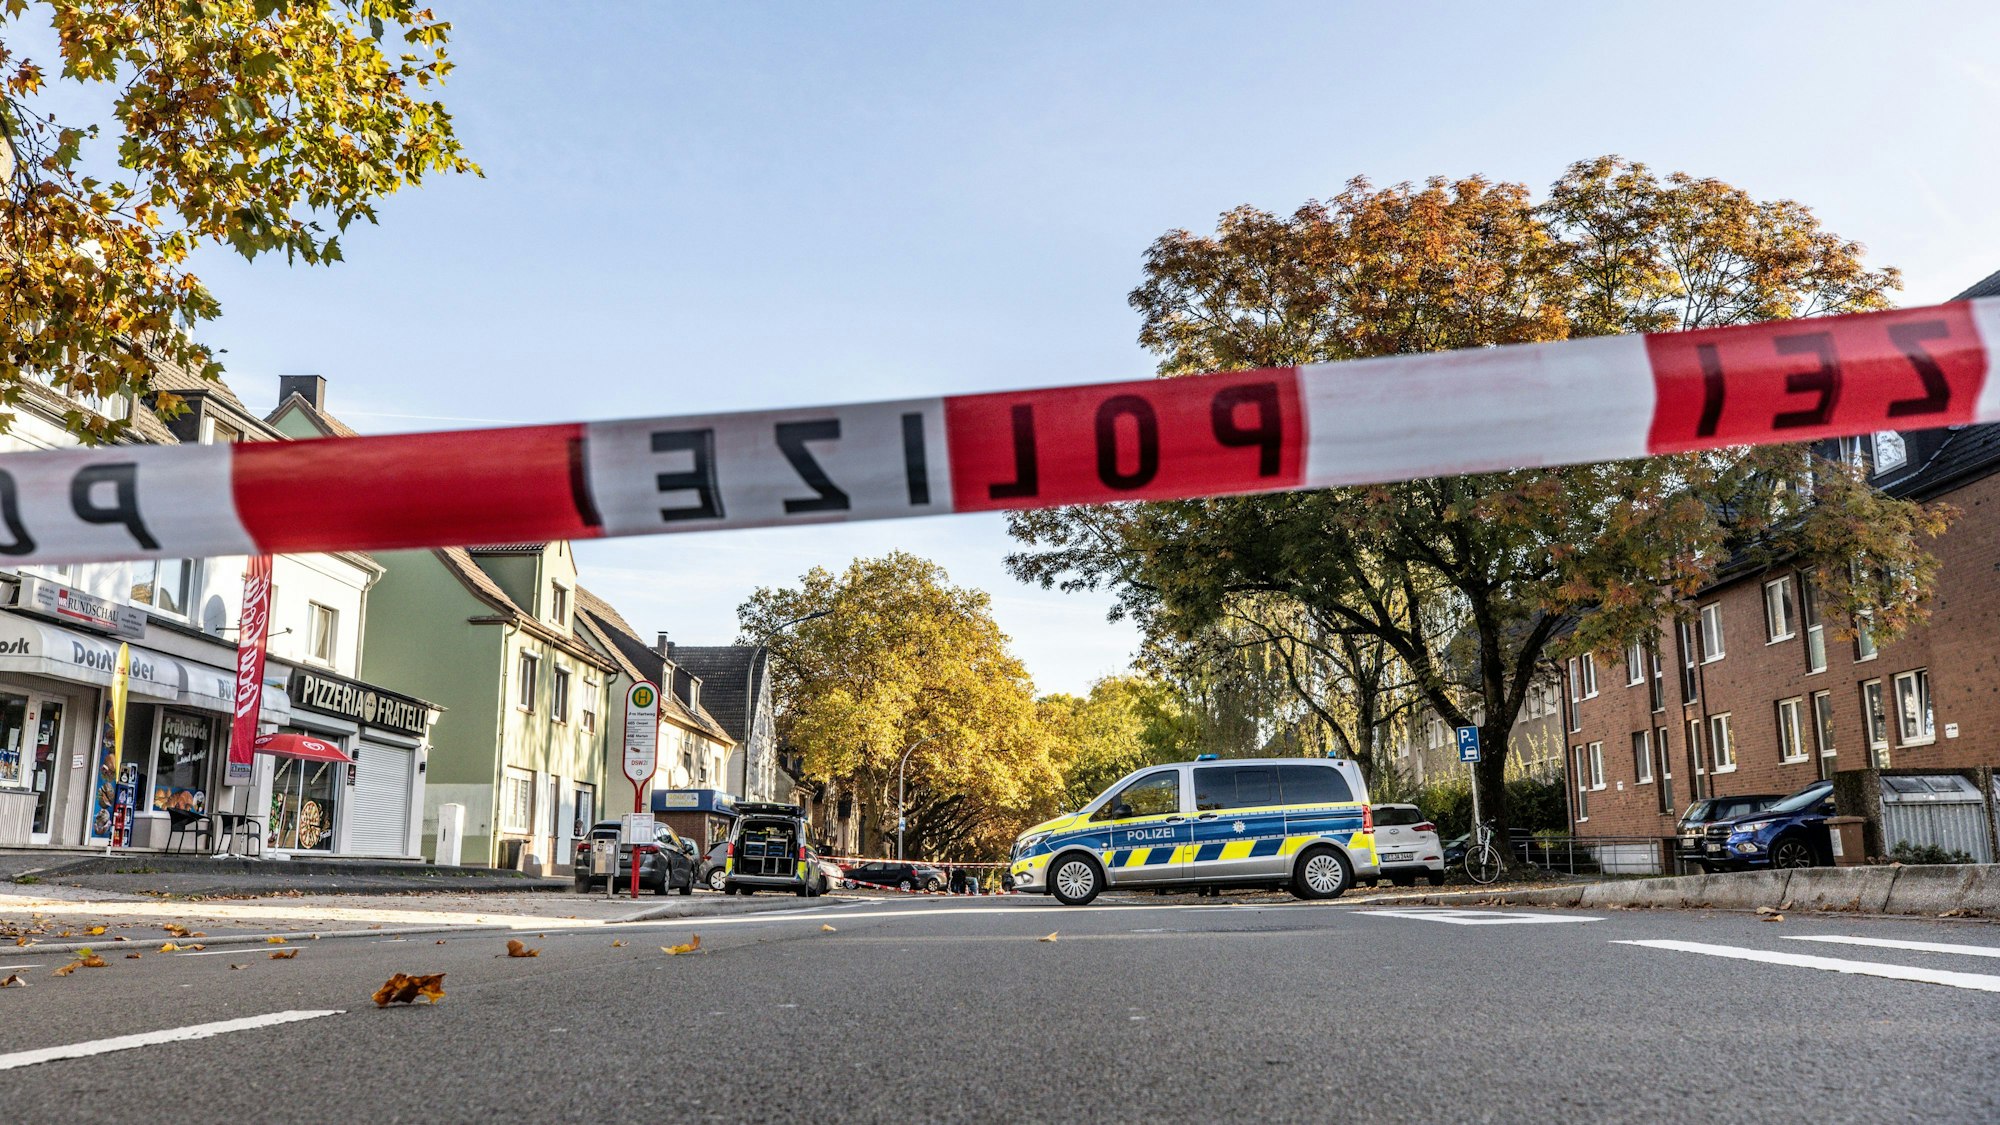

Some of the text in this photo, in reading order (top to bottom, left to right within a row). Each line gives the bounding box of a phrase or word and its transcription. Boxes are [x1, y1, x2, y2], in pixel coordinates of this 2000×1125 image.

[68, 597, 119, 622] RUNDSCHAU
[237, 570, 271, 718] Coca-Cola
[302, 674, 364, 718] PIZZERIA
[376, 696, 428, 734] FRATELLI
[638, 690, 648, 704] H
[164, 717, 208, 740] Frühstück
[1460, 729, 1470, 743] P
[162, 736, 184, 756] Café
[1127, 827, 1175, 842] POLIZEI
